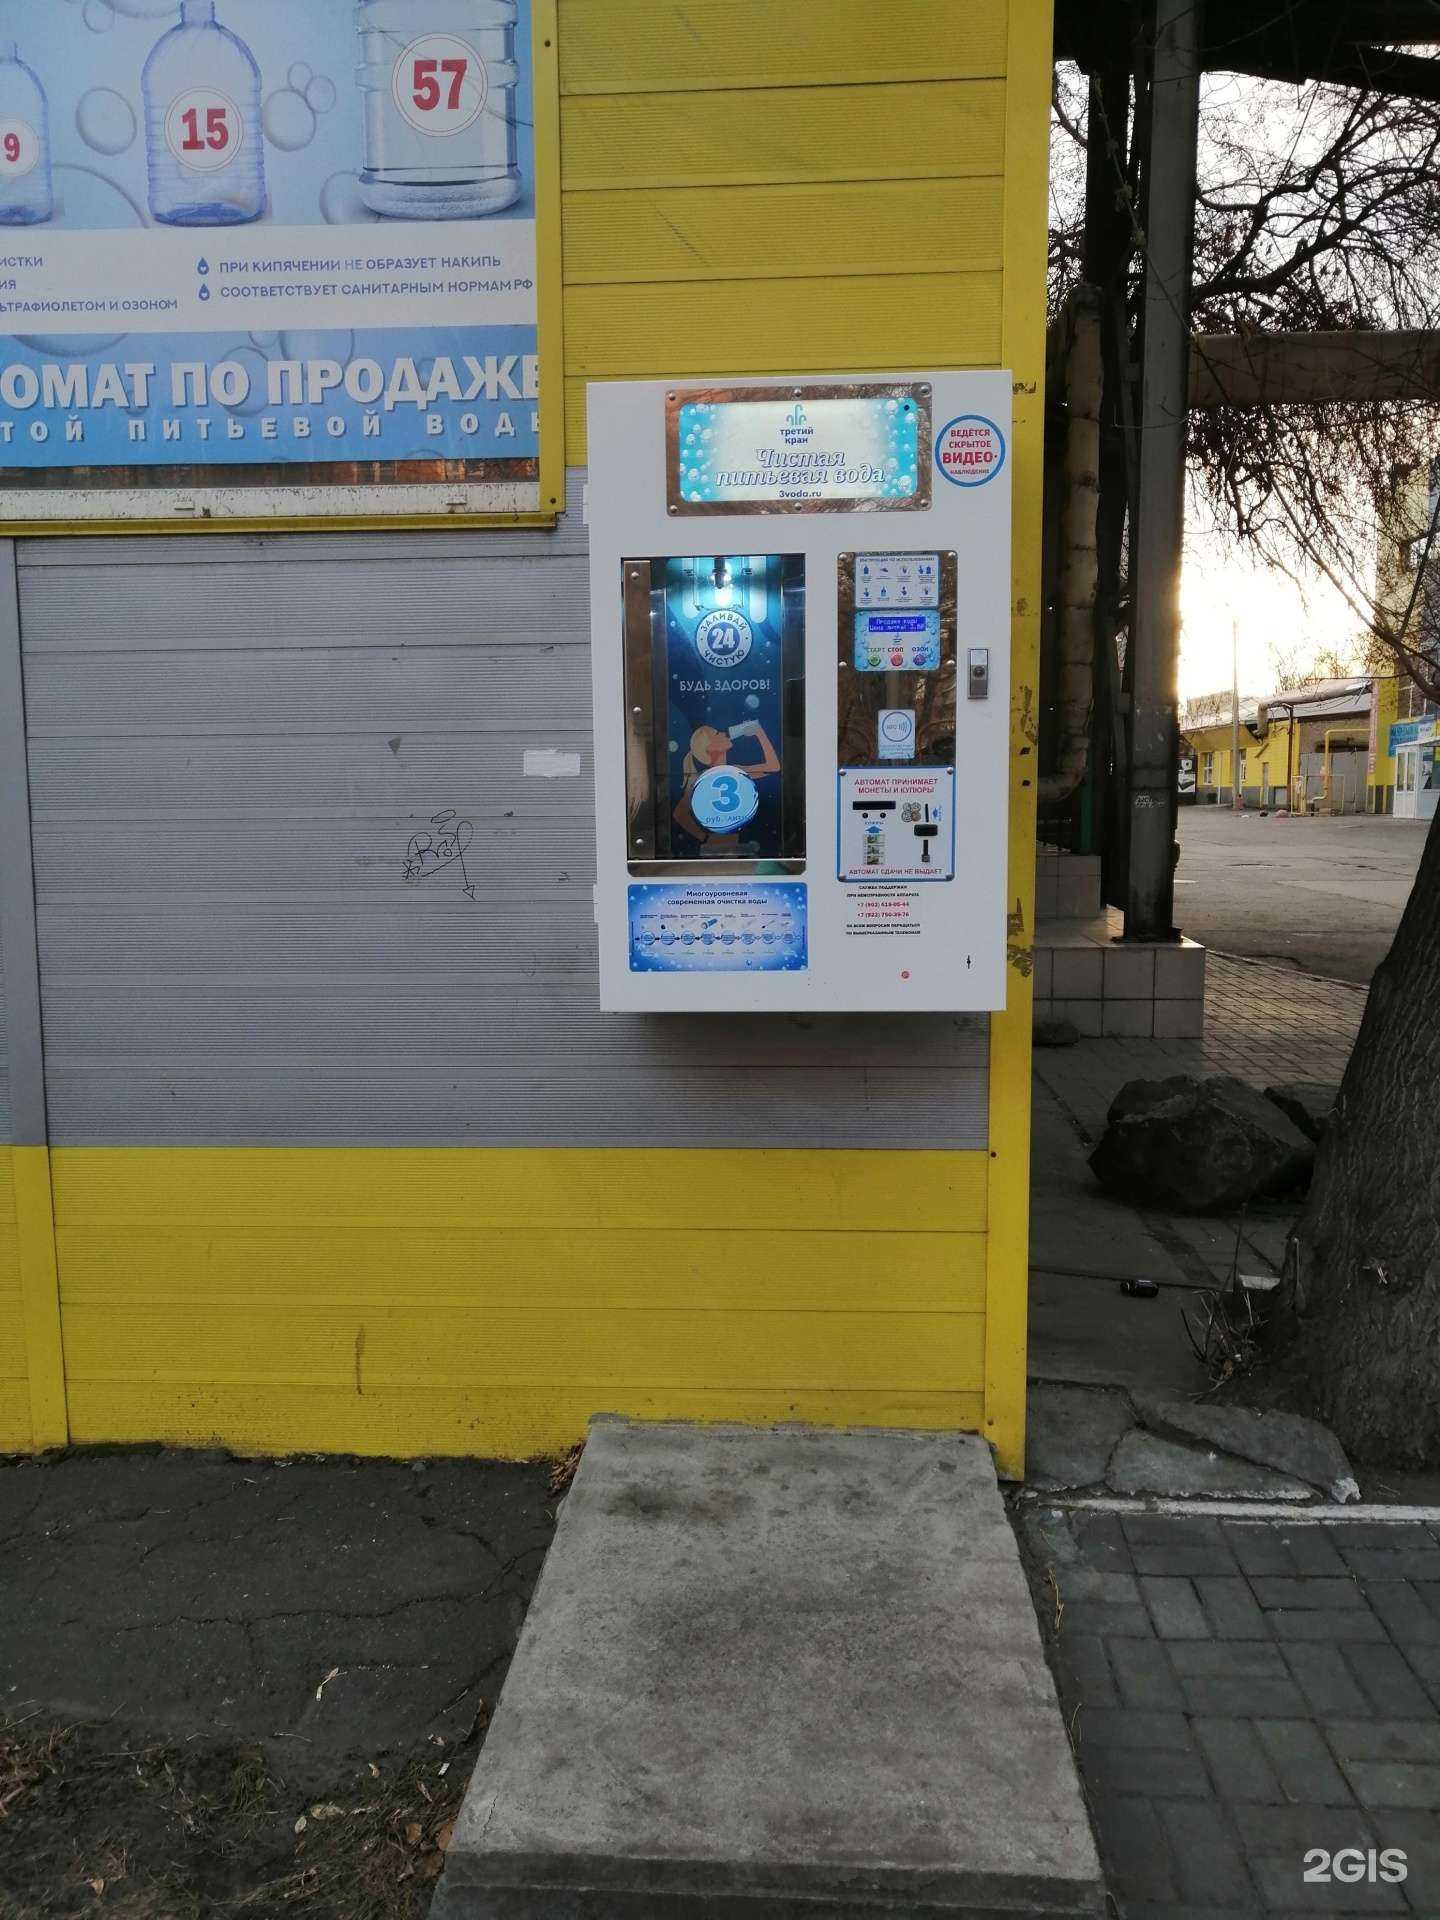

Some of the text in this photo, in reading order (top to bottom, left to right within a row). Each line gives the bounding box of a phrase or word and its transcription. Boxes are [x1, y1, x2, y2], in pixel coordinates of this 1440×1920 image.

[411, 59, 468, 111] 57
[181, 108, 229, 150] 15
[3, 133, 21, 162] 9
[219, 256, 501, 273] ПРИ КИПЯЧЕНИИ НЕ ОБРАЗУЕТ НАКИПЬ
[220, 279, 533, 298] СООТВЕТСТВУЕТ САНИТАРНЫМ НОРМАМ РФ
[109, 302, 118, 311] И
[122, 300, 177, 311] ОЗОНОМ
[171, 361, 250, 407] ПО
[267, 355, 538, 411] ПРОДАЖЕ
[128, 409, 381, 441] ПИТЬЕВОЙ
[780, 427, 814, 437] третий
[785, 436, 809, 445] кран
[949, 440, 992, 448] СКРЫТОЕ
[756, 449, 846, 468] Чистая
[715, 463, 886, 486] питьевая вода
[779, 489, 822, 498] 3voda.ru
[701, 612, 747, 632] ЗАЛИВАЙ
[711, 628, 735, 649] 24
[704, 649, 745, 665] ЧИСТУЮ
[680, 680, 770, 691] БУДЬ ЗДОРОВ!
[711, 775, 741, 813] 3
[686, 890, 748, 898] Многоуровневая
